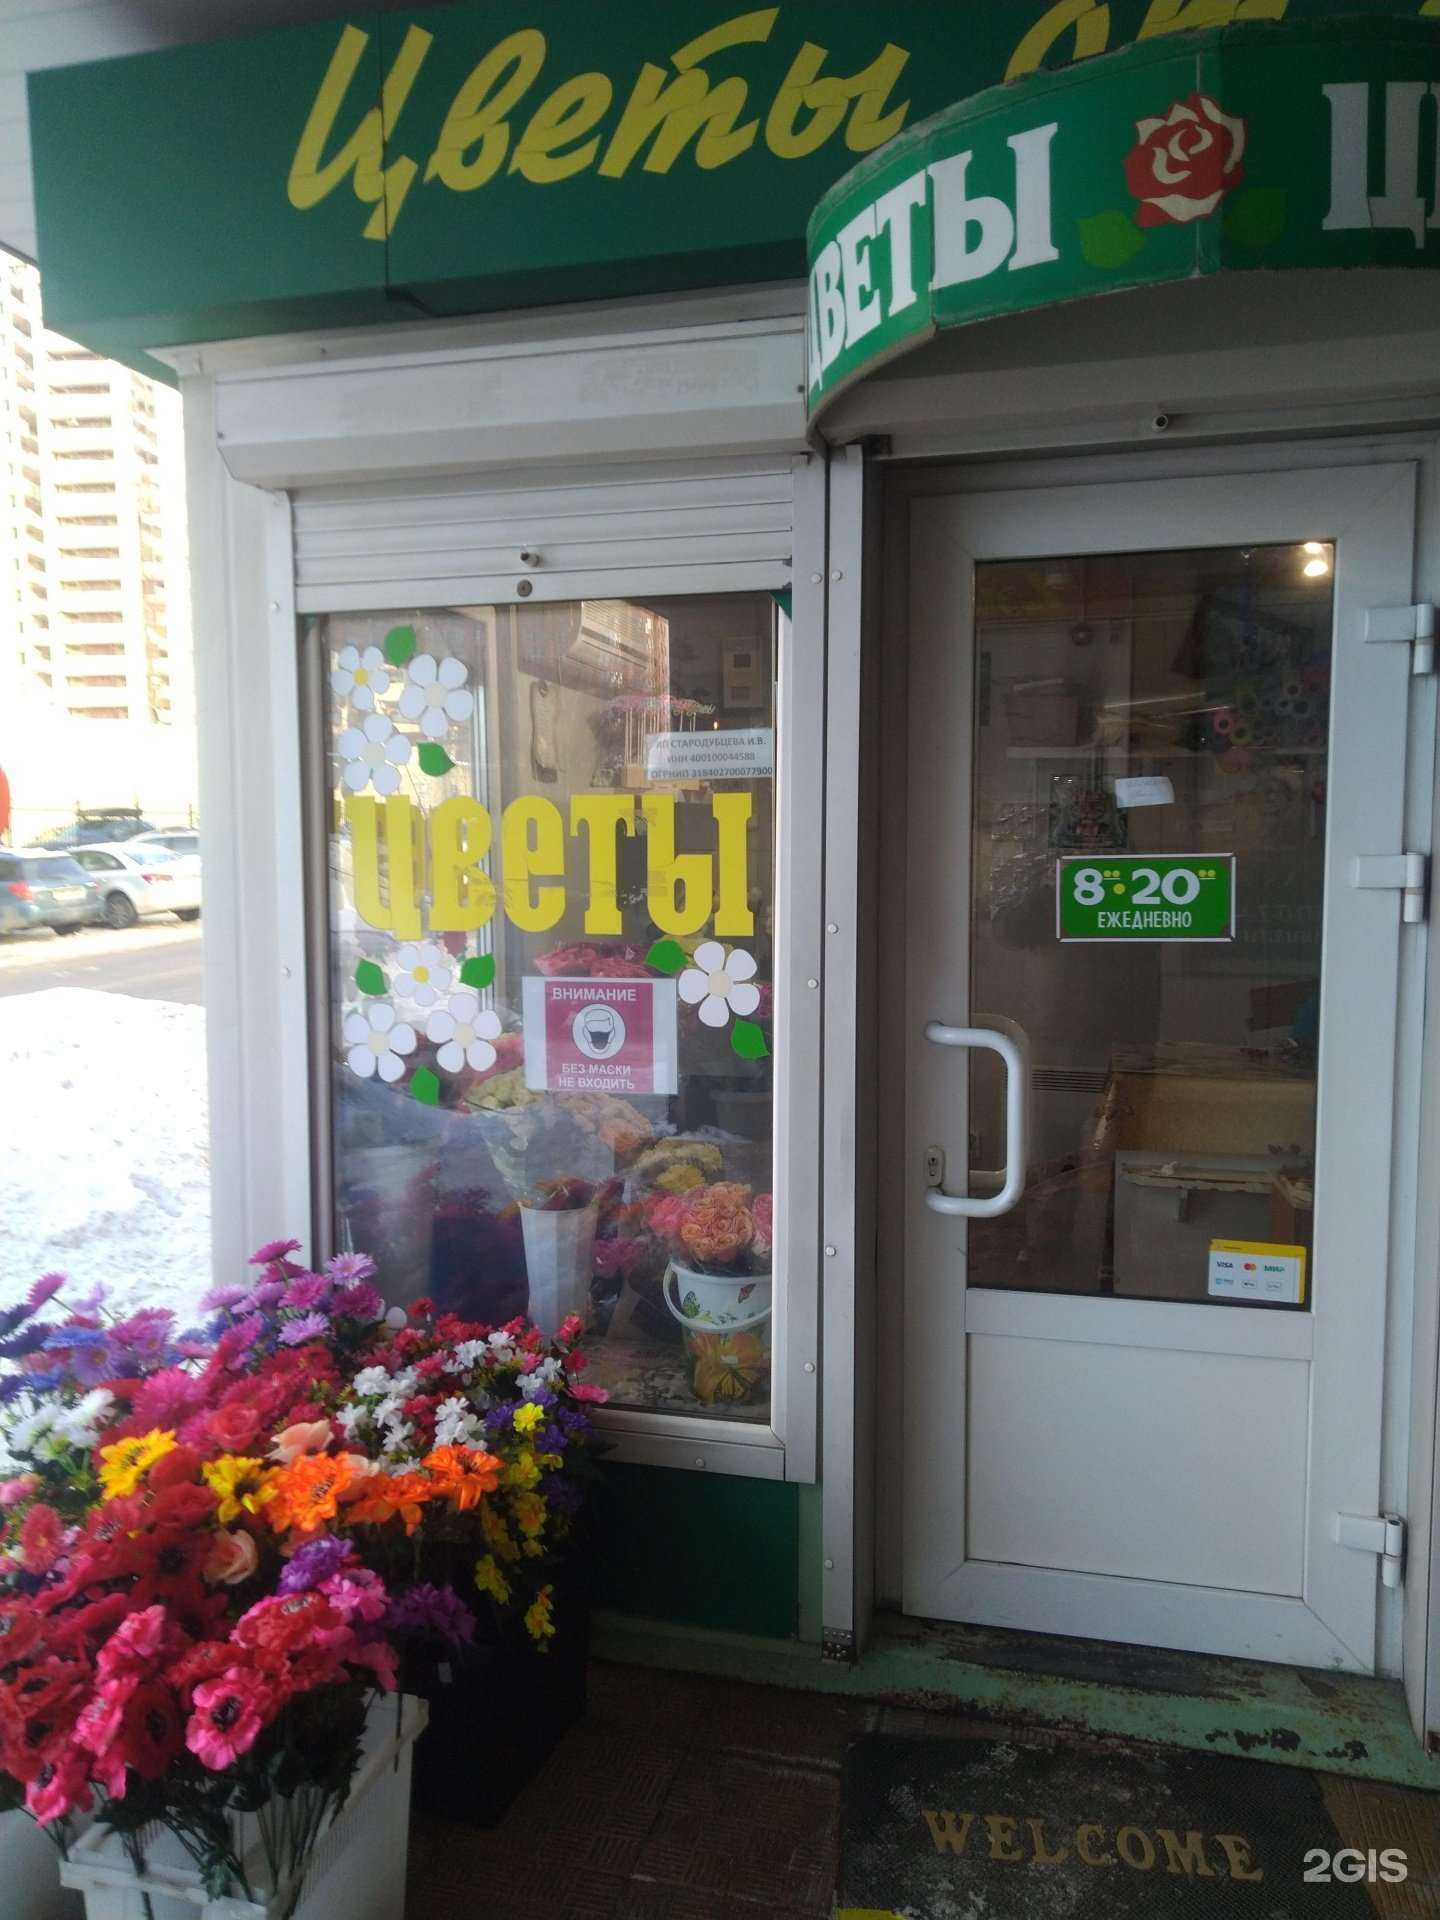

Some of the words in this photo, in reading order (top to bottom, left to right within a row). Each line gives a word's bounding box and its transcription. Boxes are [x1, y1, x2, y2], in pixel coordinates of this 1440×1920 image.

[288, 7, 910, 241] Цветы
[1321, 81, 1440, 249] Ц
[670, 736, 745, 749] СТАРОДУБЦЕВА
[747, 735, 767, 746] И.В.
[651, 768, 689, 779] ОГРНИП
[1097, 911, 1192, 930] ЕЖЕДНЕВНО
[552, 987, 637, 1001] ВНИМАНИЕ
[561, 1063, 586, 1074] БЕЗ
[589, 1064, 631, 1075] МАСКИ
[558, 1077, 575, 1088] НЕ
[578, 1078, 635, 1089] ВХОДИТЬ
[1216, 1261, 1234, 1269] VISA
[922, 1808, 1264, 1883] WELCOME
